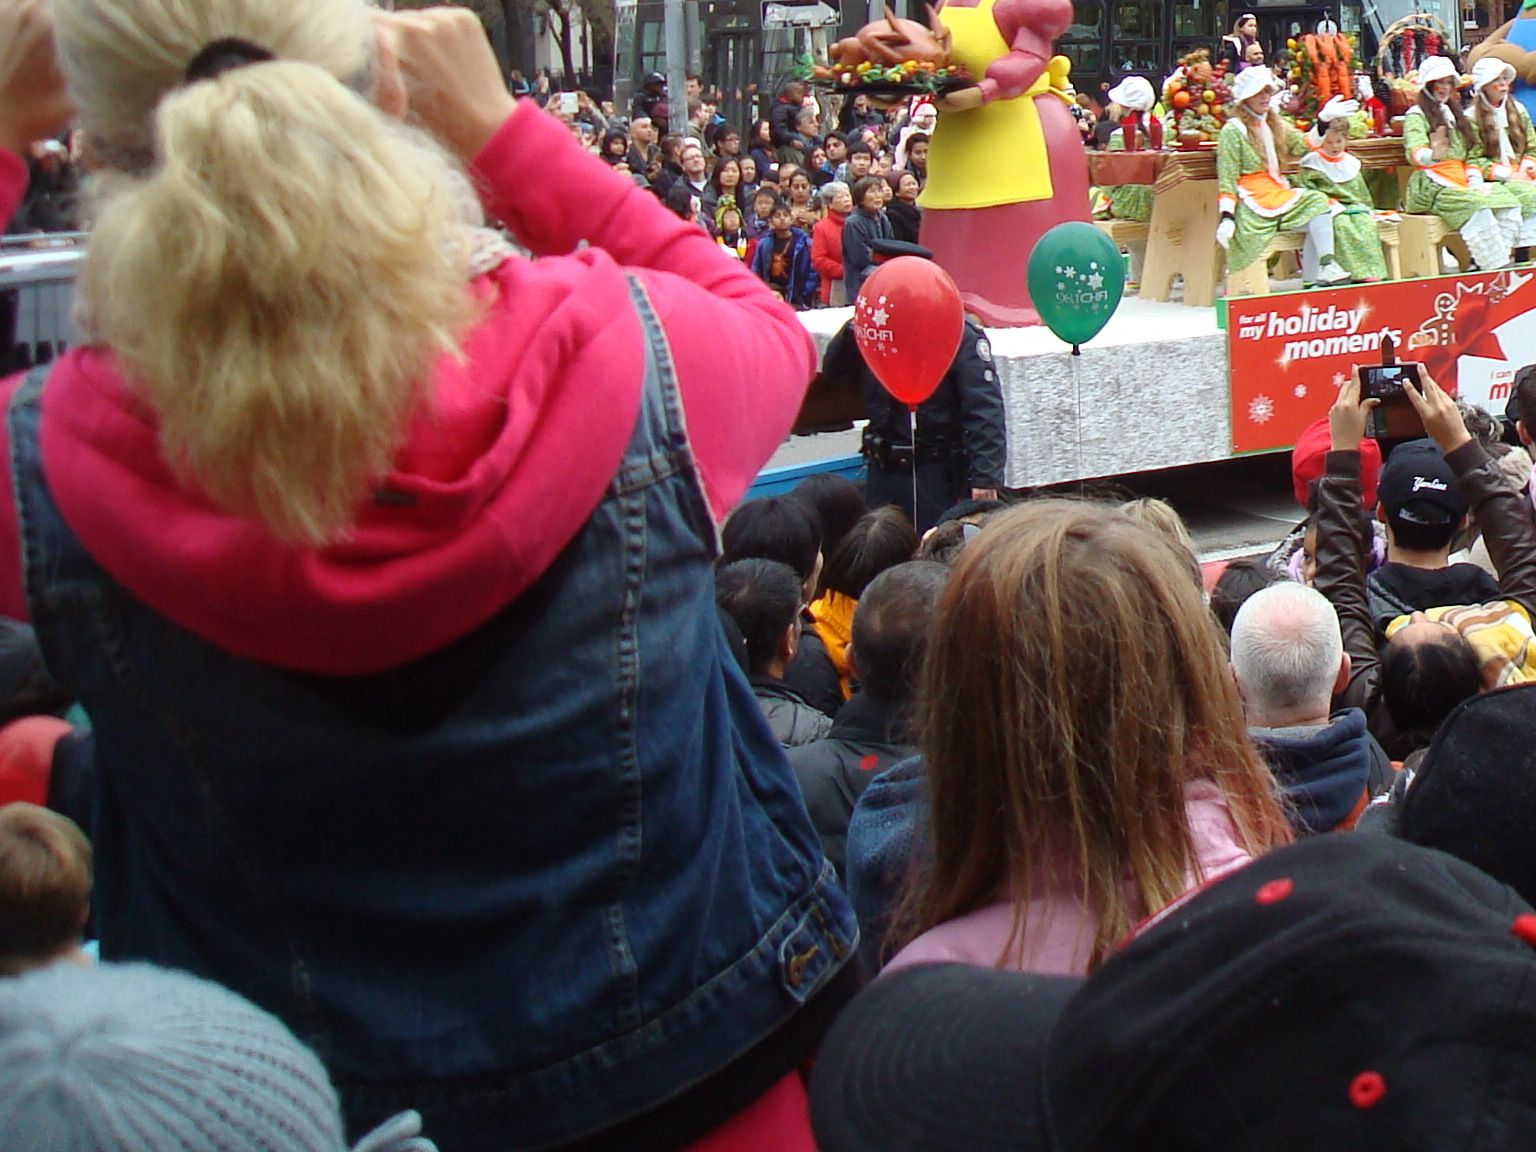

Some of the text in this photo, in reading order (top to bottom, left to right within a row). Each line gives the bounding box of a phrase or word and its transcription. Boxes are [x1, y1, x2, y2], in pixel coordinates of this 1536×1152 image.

[1239, 313, 1267, 325] for all
[1239, 306, 1363, 341] my holiday
[1489, 382, 1514, 400] m
